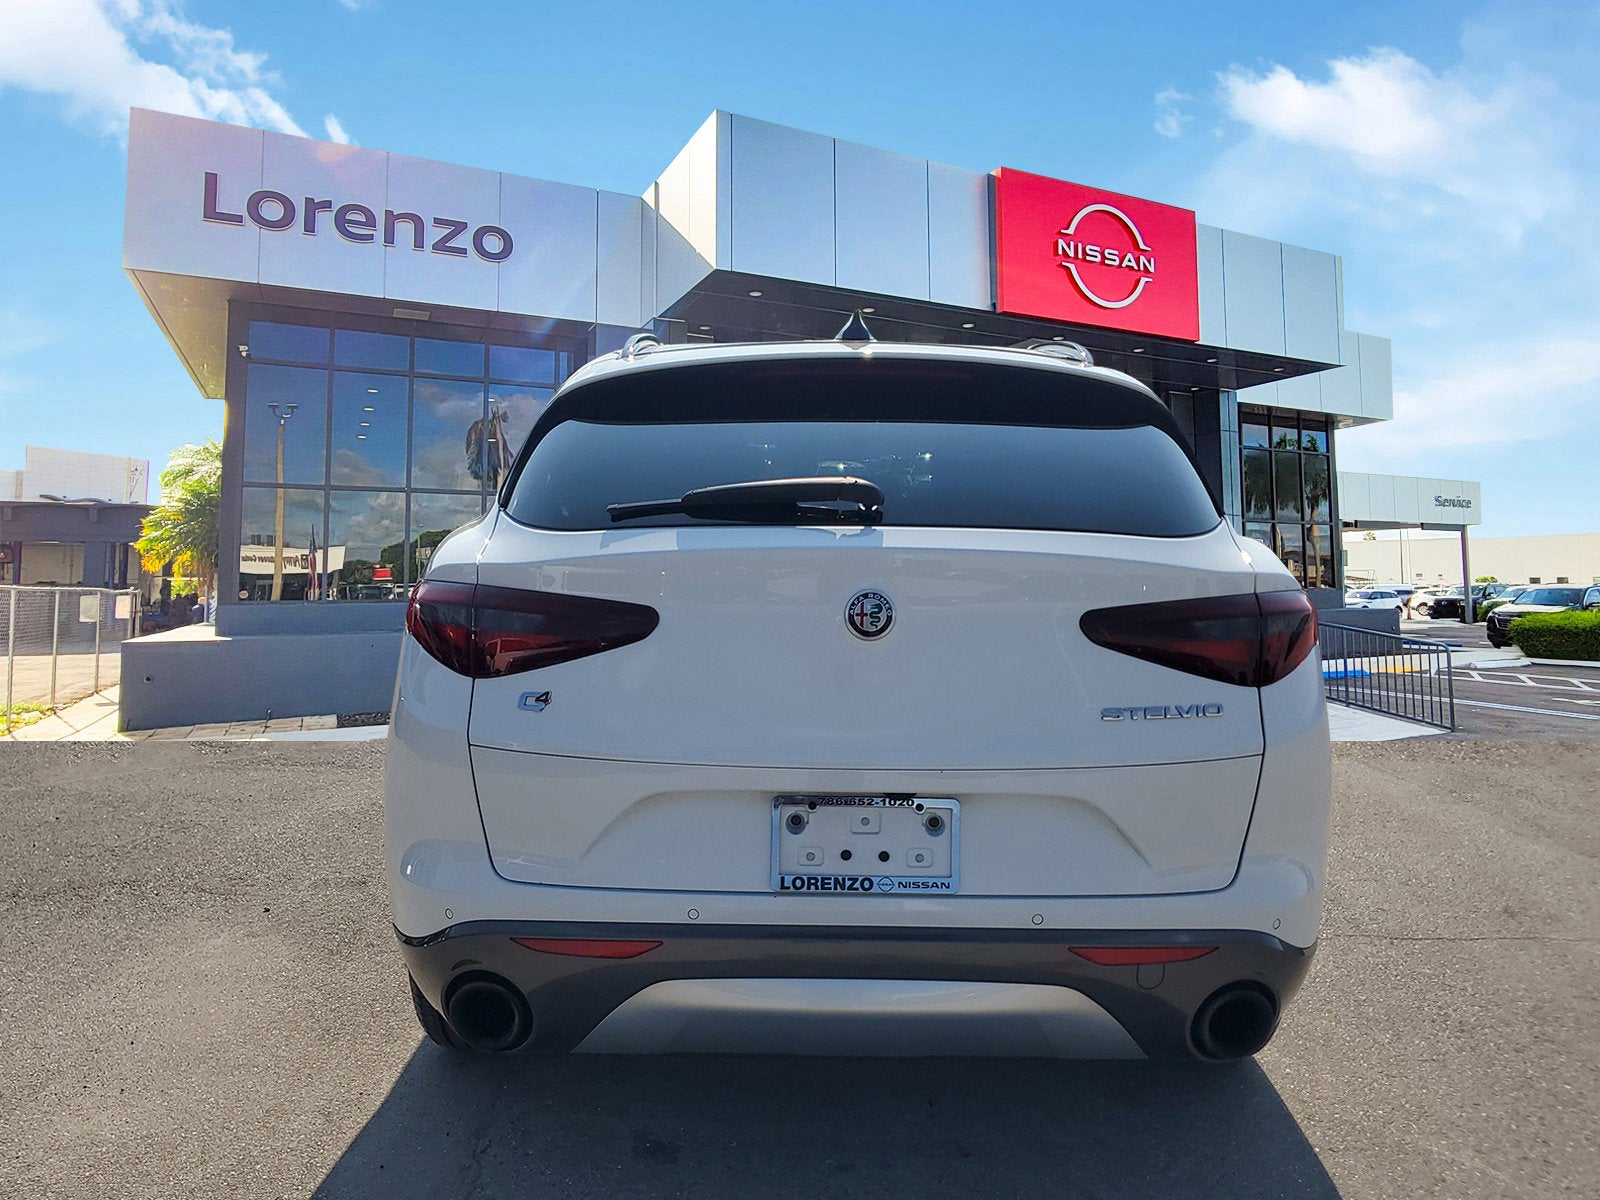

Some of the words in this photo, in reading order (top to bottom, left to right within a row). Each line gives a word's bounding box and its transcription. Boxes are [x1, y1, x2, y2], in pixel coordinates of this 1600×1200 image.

[202, 170, 514, 262] Lorenzo
[1057, 238, 1155, 273] NISSAN
[1434, 495, 1473, 509] Service
[849, 596, 865, 615] ALFA
[868, 593, 892, 616] ROMEO
[1100, 702, 1224, 721] STELVIO
[780, 876, 874, 892] LORENZO
[898, 881, 951, 889] NISSAN
